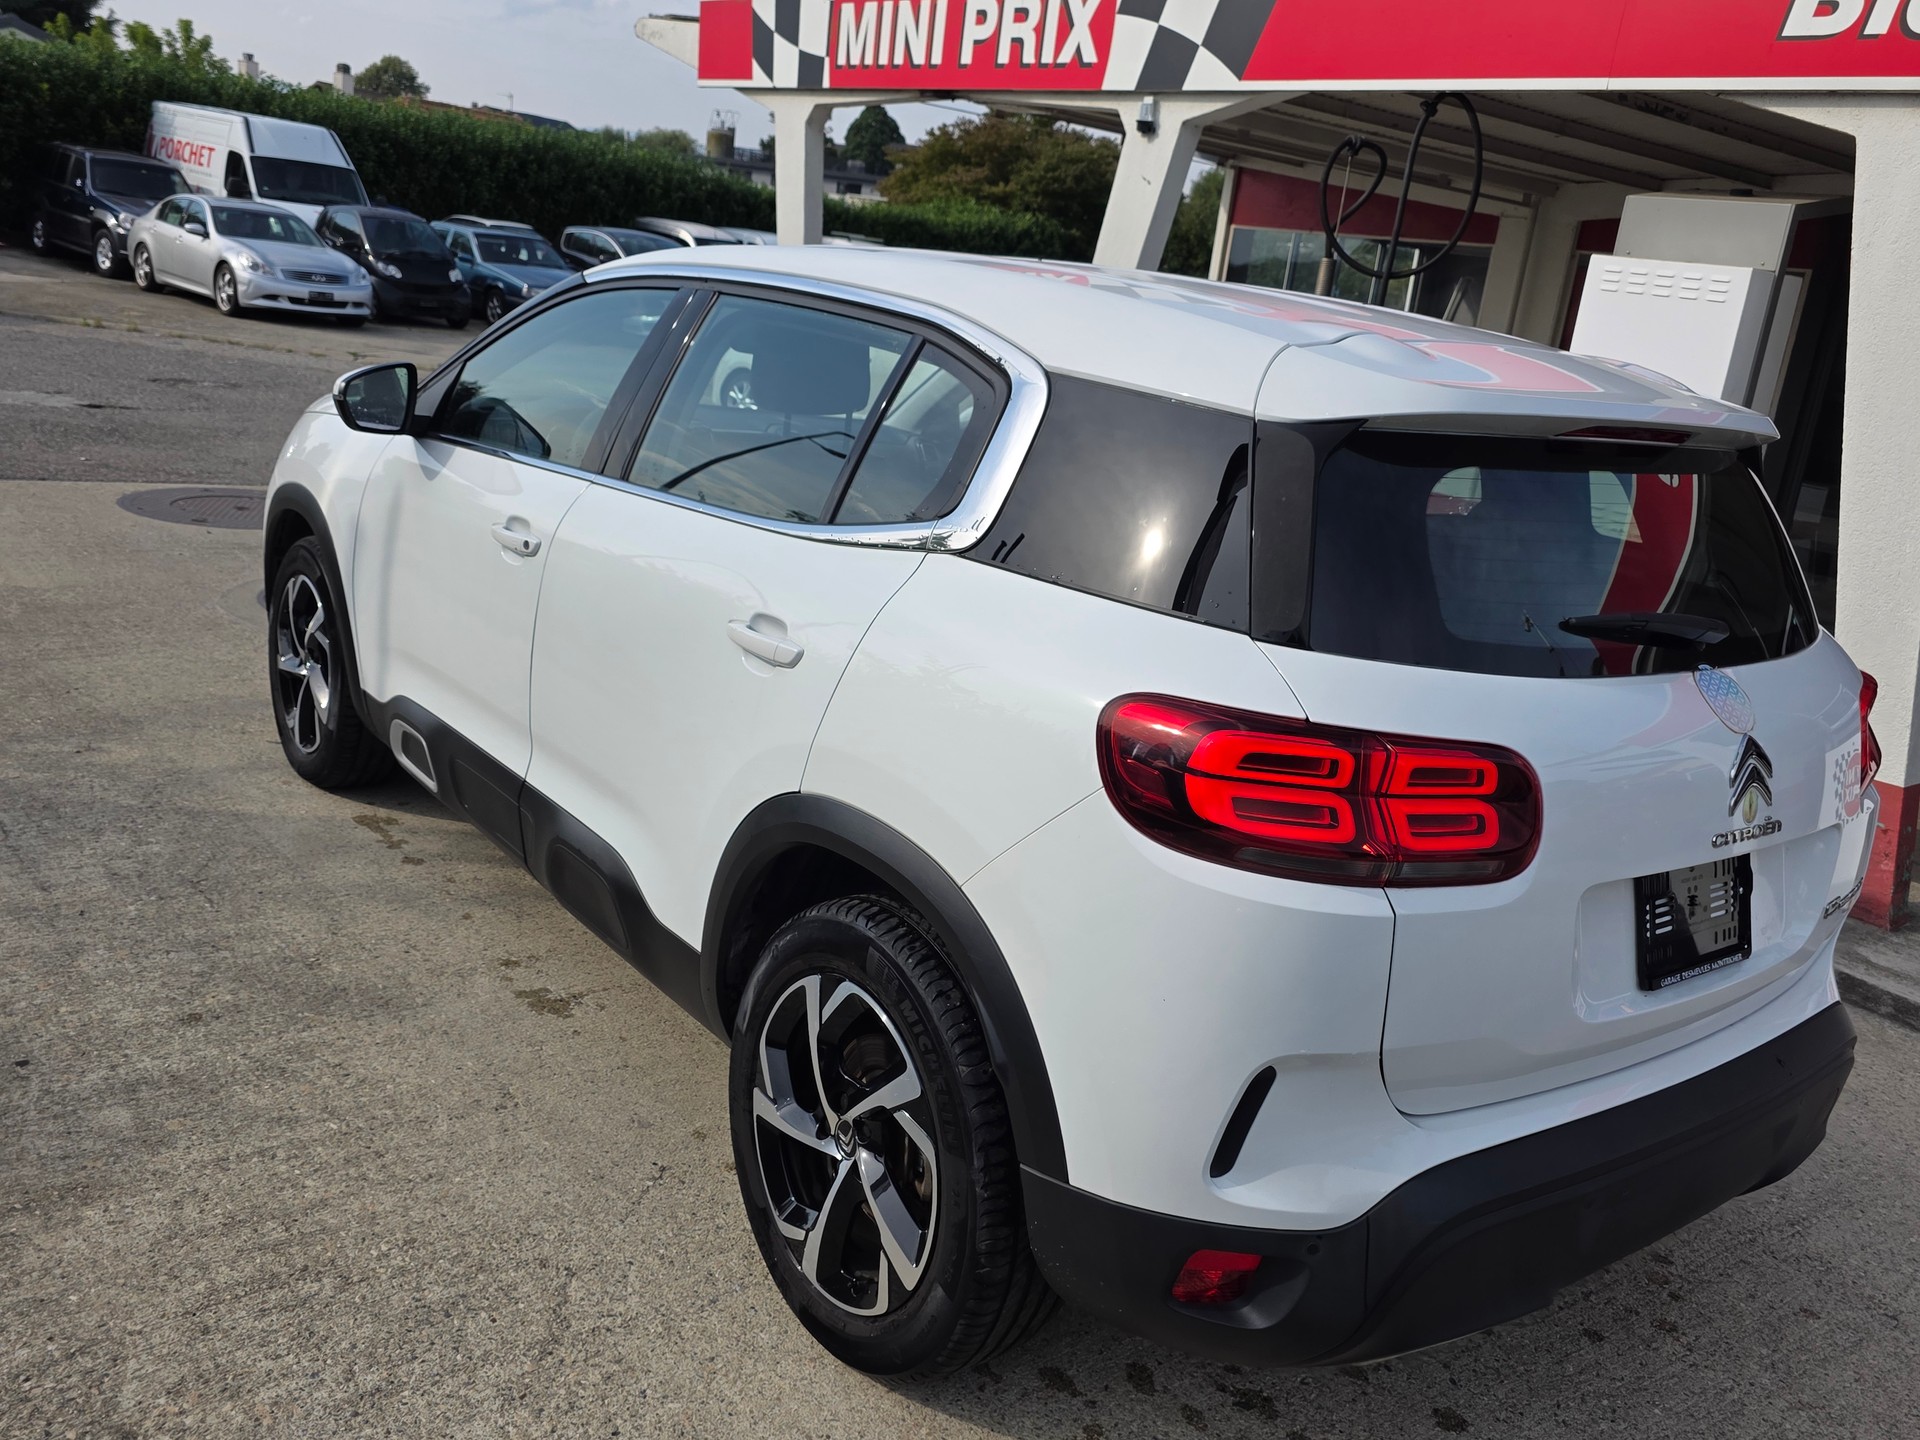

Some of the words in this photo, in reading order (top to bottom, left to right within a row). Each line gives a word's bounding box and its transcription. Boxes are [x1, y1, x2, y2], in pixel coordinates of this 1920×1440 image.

[835, 0, 949, 68] MINI
[958, 0, 1099, 68] PRIX
[159, 136, 216, 168] PORCHET
[1660, 973, 1682, 987] GARAGE
[899, 999, 961, 1153] MICHELIN
